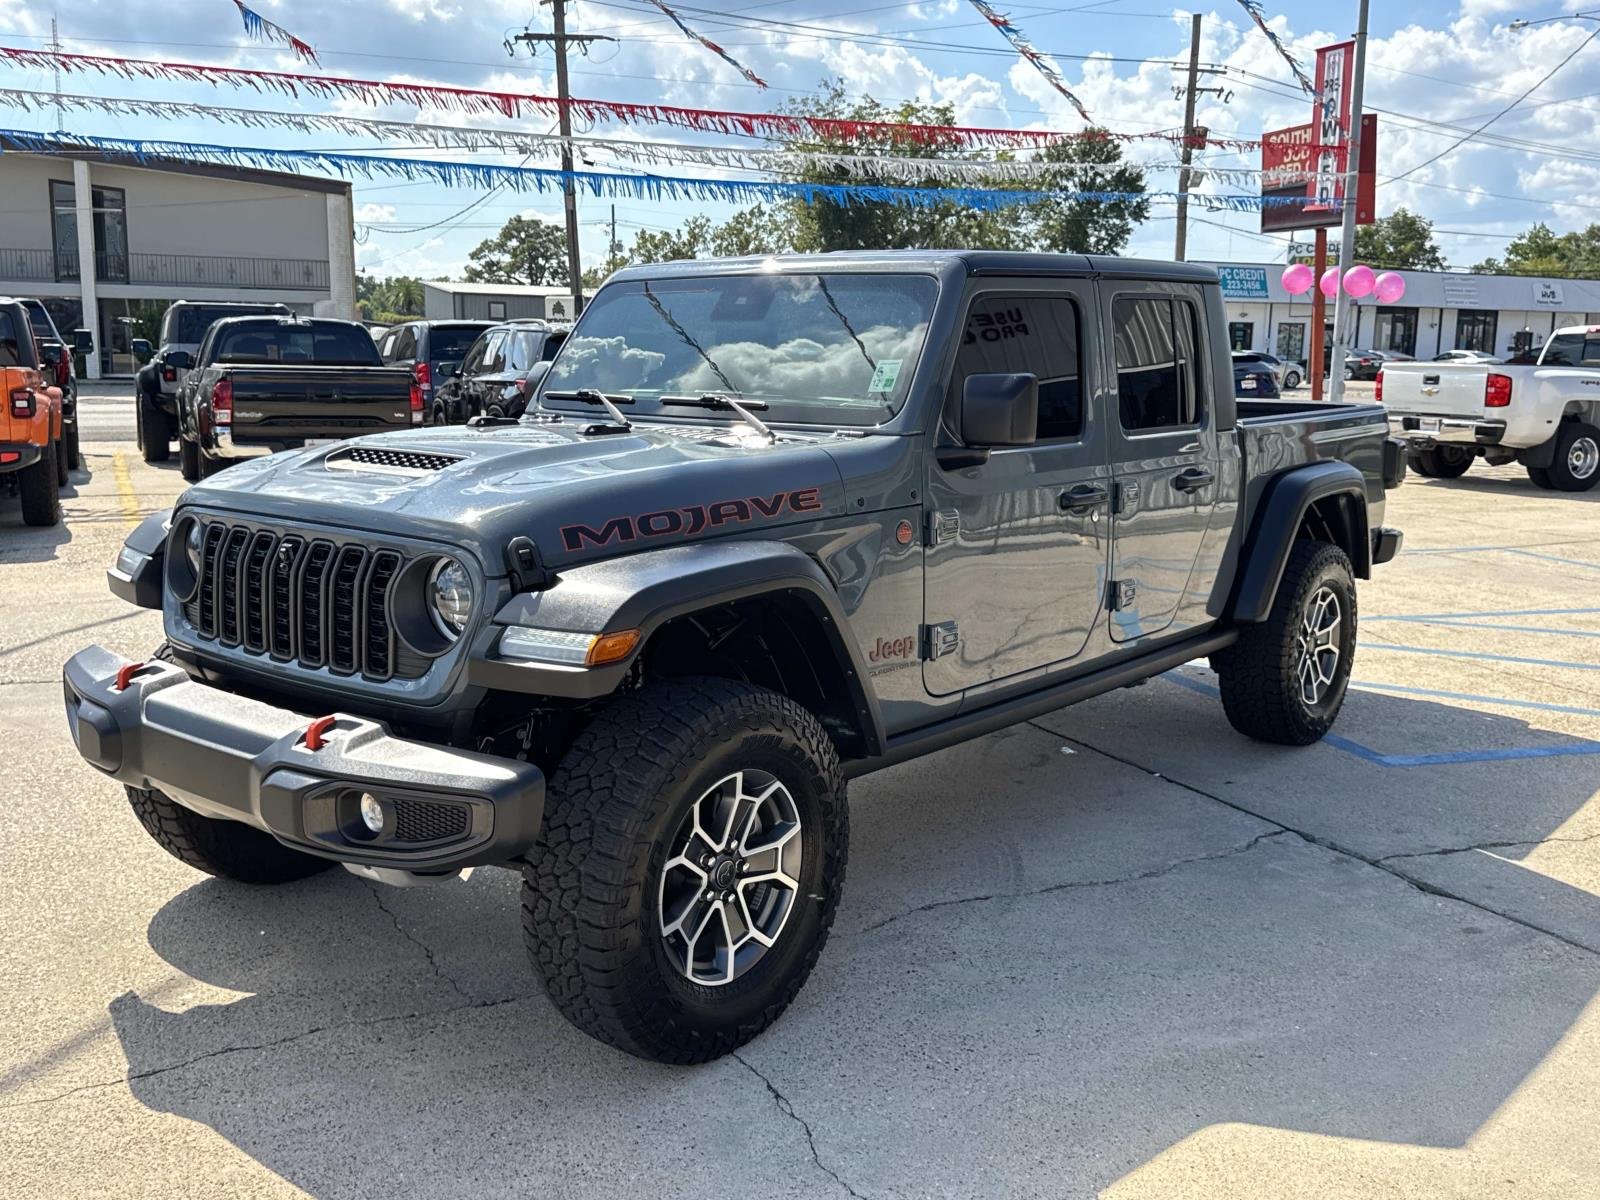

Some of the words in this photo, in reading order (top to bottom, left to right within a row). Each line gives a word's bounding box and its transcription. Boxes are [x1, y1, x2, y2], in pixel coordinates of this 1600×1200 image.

[1288, 244, 1303, 254] PC
[1218, 268, 1232, 280] PC
[1233, 269, 1265, 281] CREDIT
[560, 488, 822, 551] MOJAVE
[868, 635, 913, 662] Jeep
